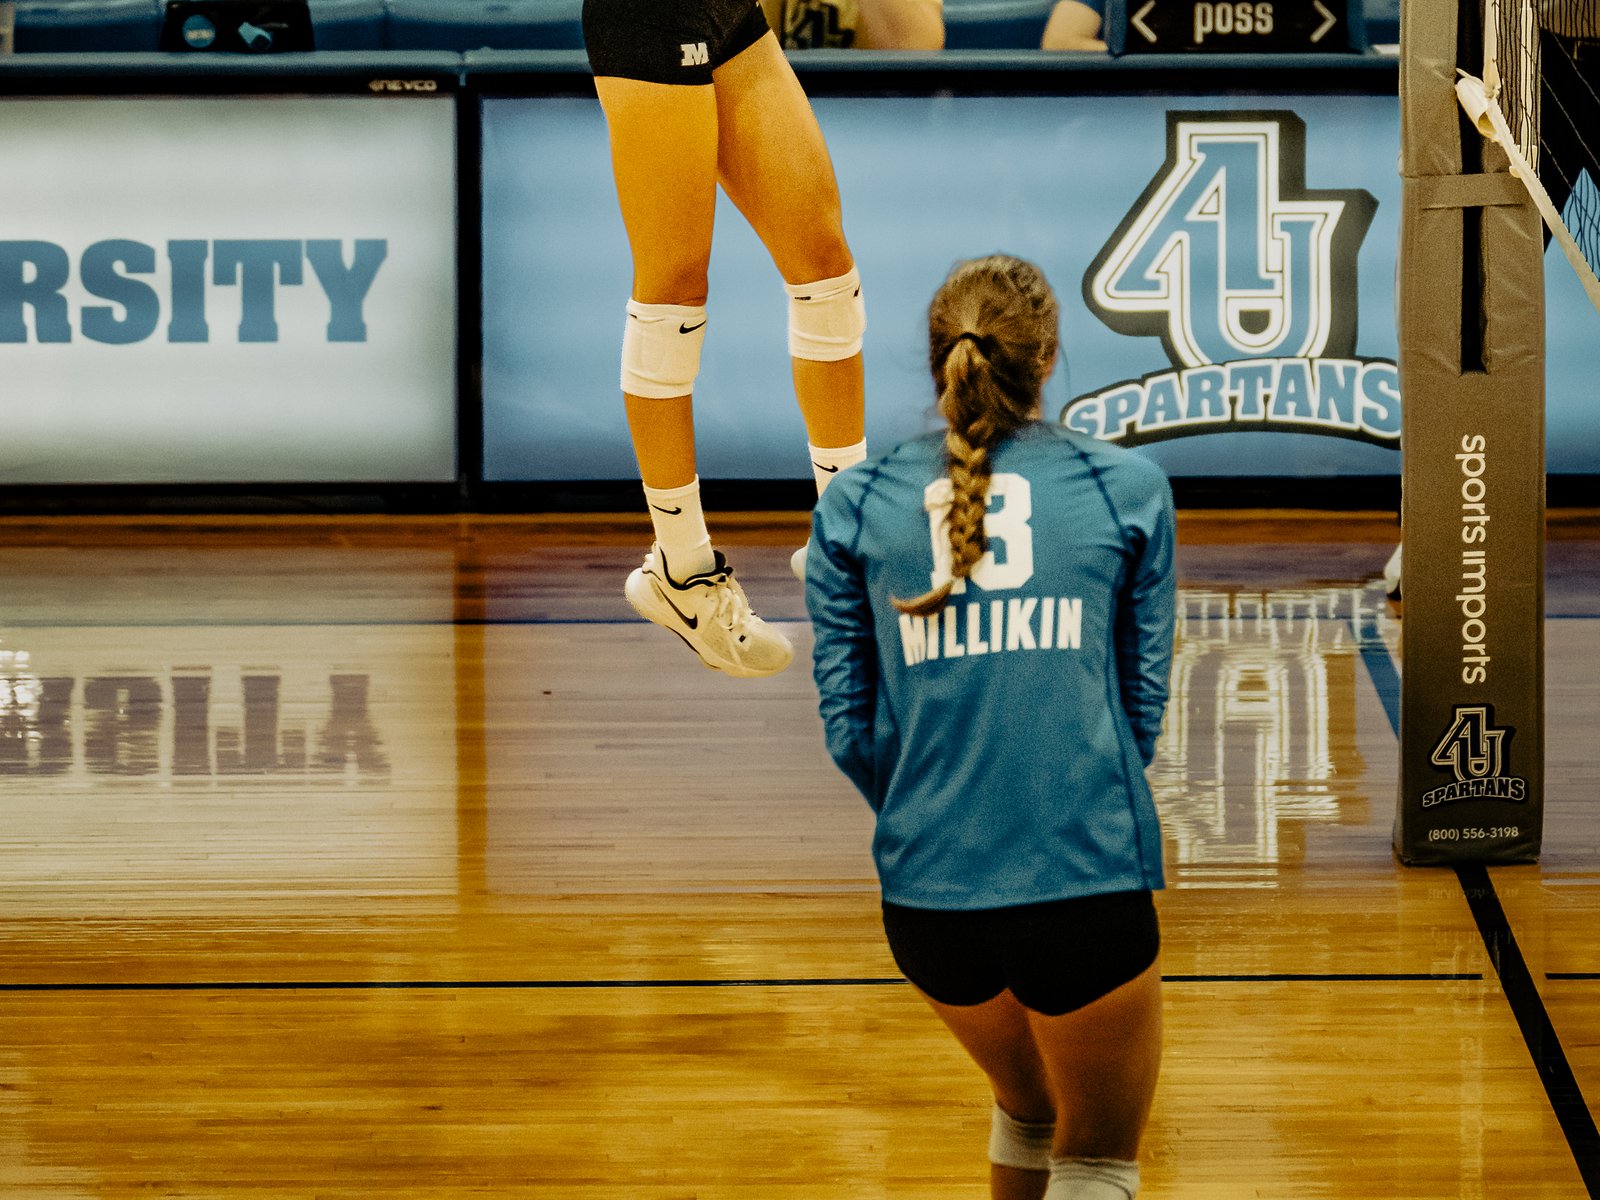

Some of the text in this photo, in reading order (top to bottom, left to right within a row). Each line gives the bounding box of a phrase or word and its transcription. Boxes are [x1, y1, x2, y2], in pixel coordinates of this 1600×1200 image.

[1194, 2, 1273, 44] poss
[680, 42, 710, 67] M
[1063, 357, 1401, 440] SPARTANS
[924, 473, 1034, 594] 13
[1455, 434, 1490, 684] sports imports
[898, 597, 1083, 667] MILLIKIN
[1422, 777, 1525, 808] SPARTANS
[1428, 826, 1519, 842] (800) 556-3198
